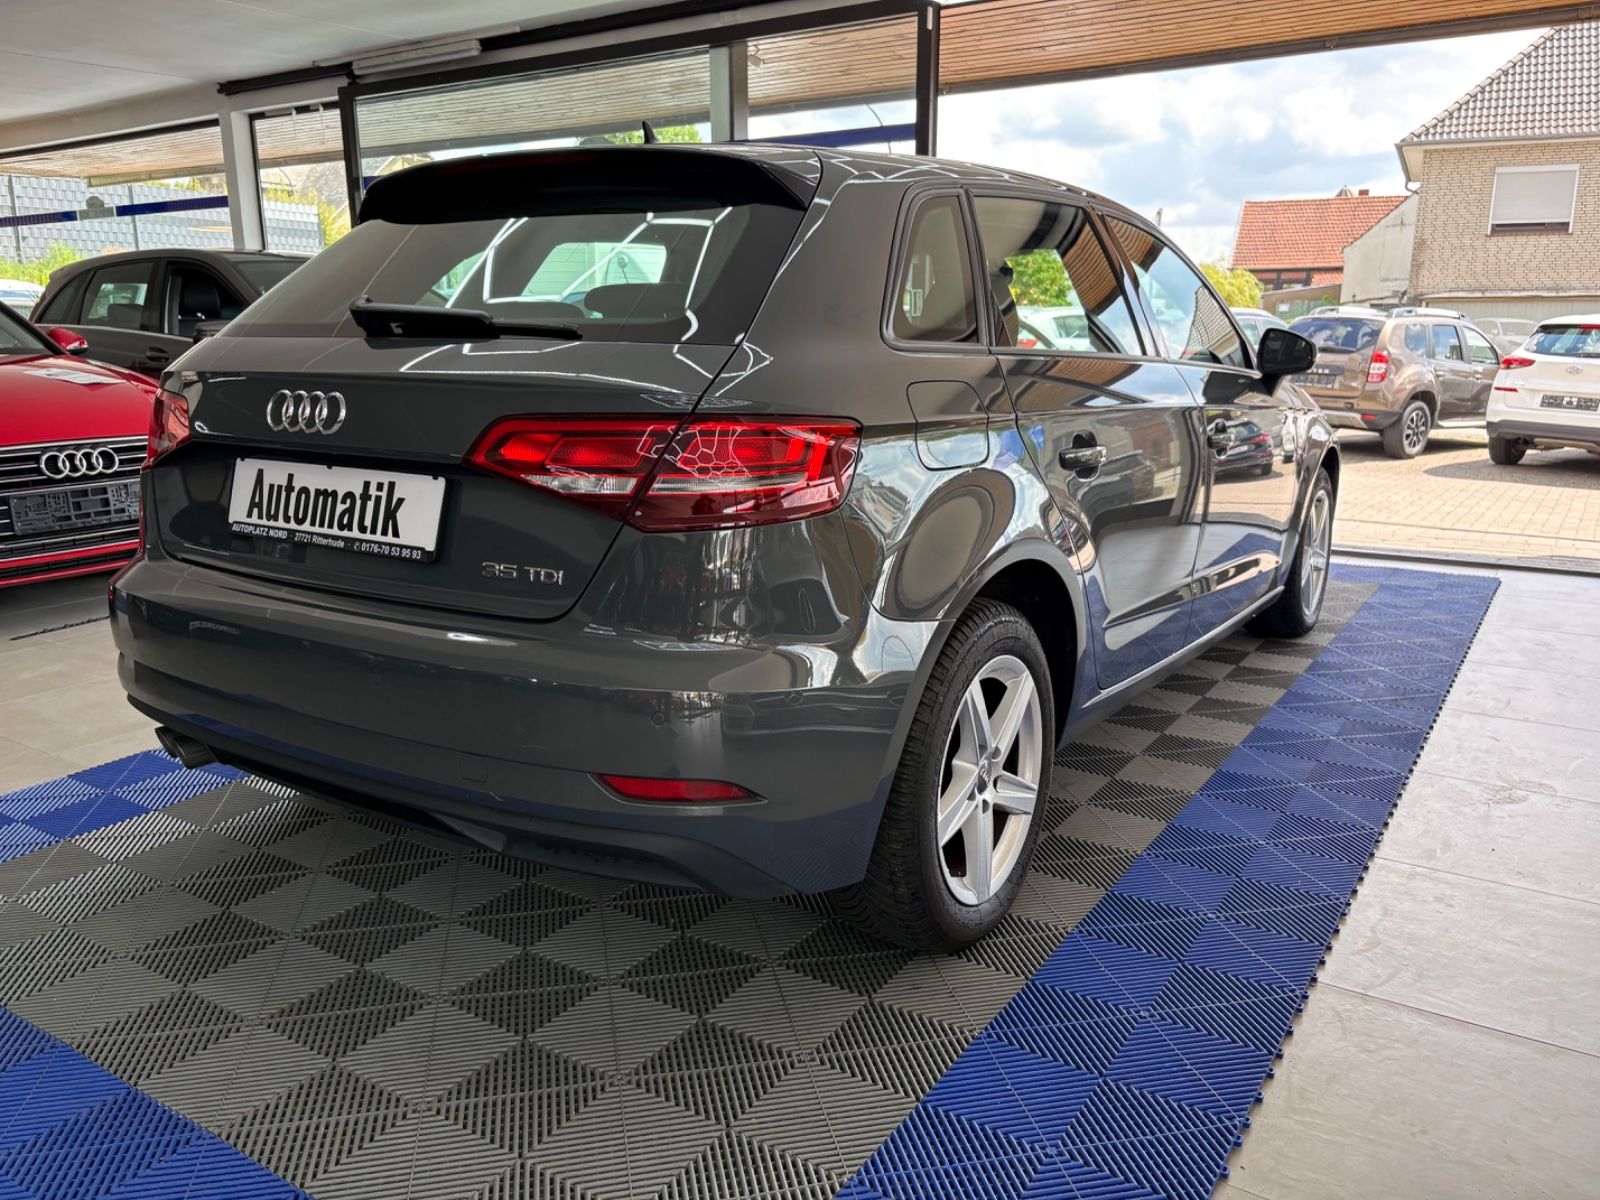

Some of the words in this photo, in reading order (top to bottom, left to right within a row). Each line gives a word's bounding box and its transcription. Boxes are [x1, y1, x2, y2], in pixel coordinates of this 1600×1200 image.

[247, 468, 406, 538] Automatik
[232, 523, 268, 536] AUTOPLATZ
[268, 529, 288, 539] NORD
[294, 532, 311, 542] 27721
[361, 542, 390, 555] 0176-70
[390, 546, 401, 557] 53
[401, 548, 411, 559] 95
[411, 550, 422, 560] 93
[481, 561, 518, 578] 35
[523, 565, 564, 586] TDI
